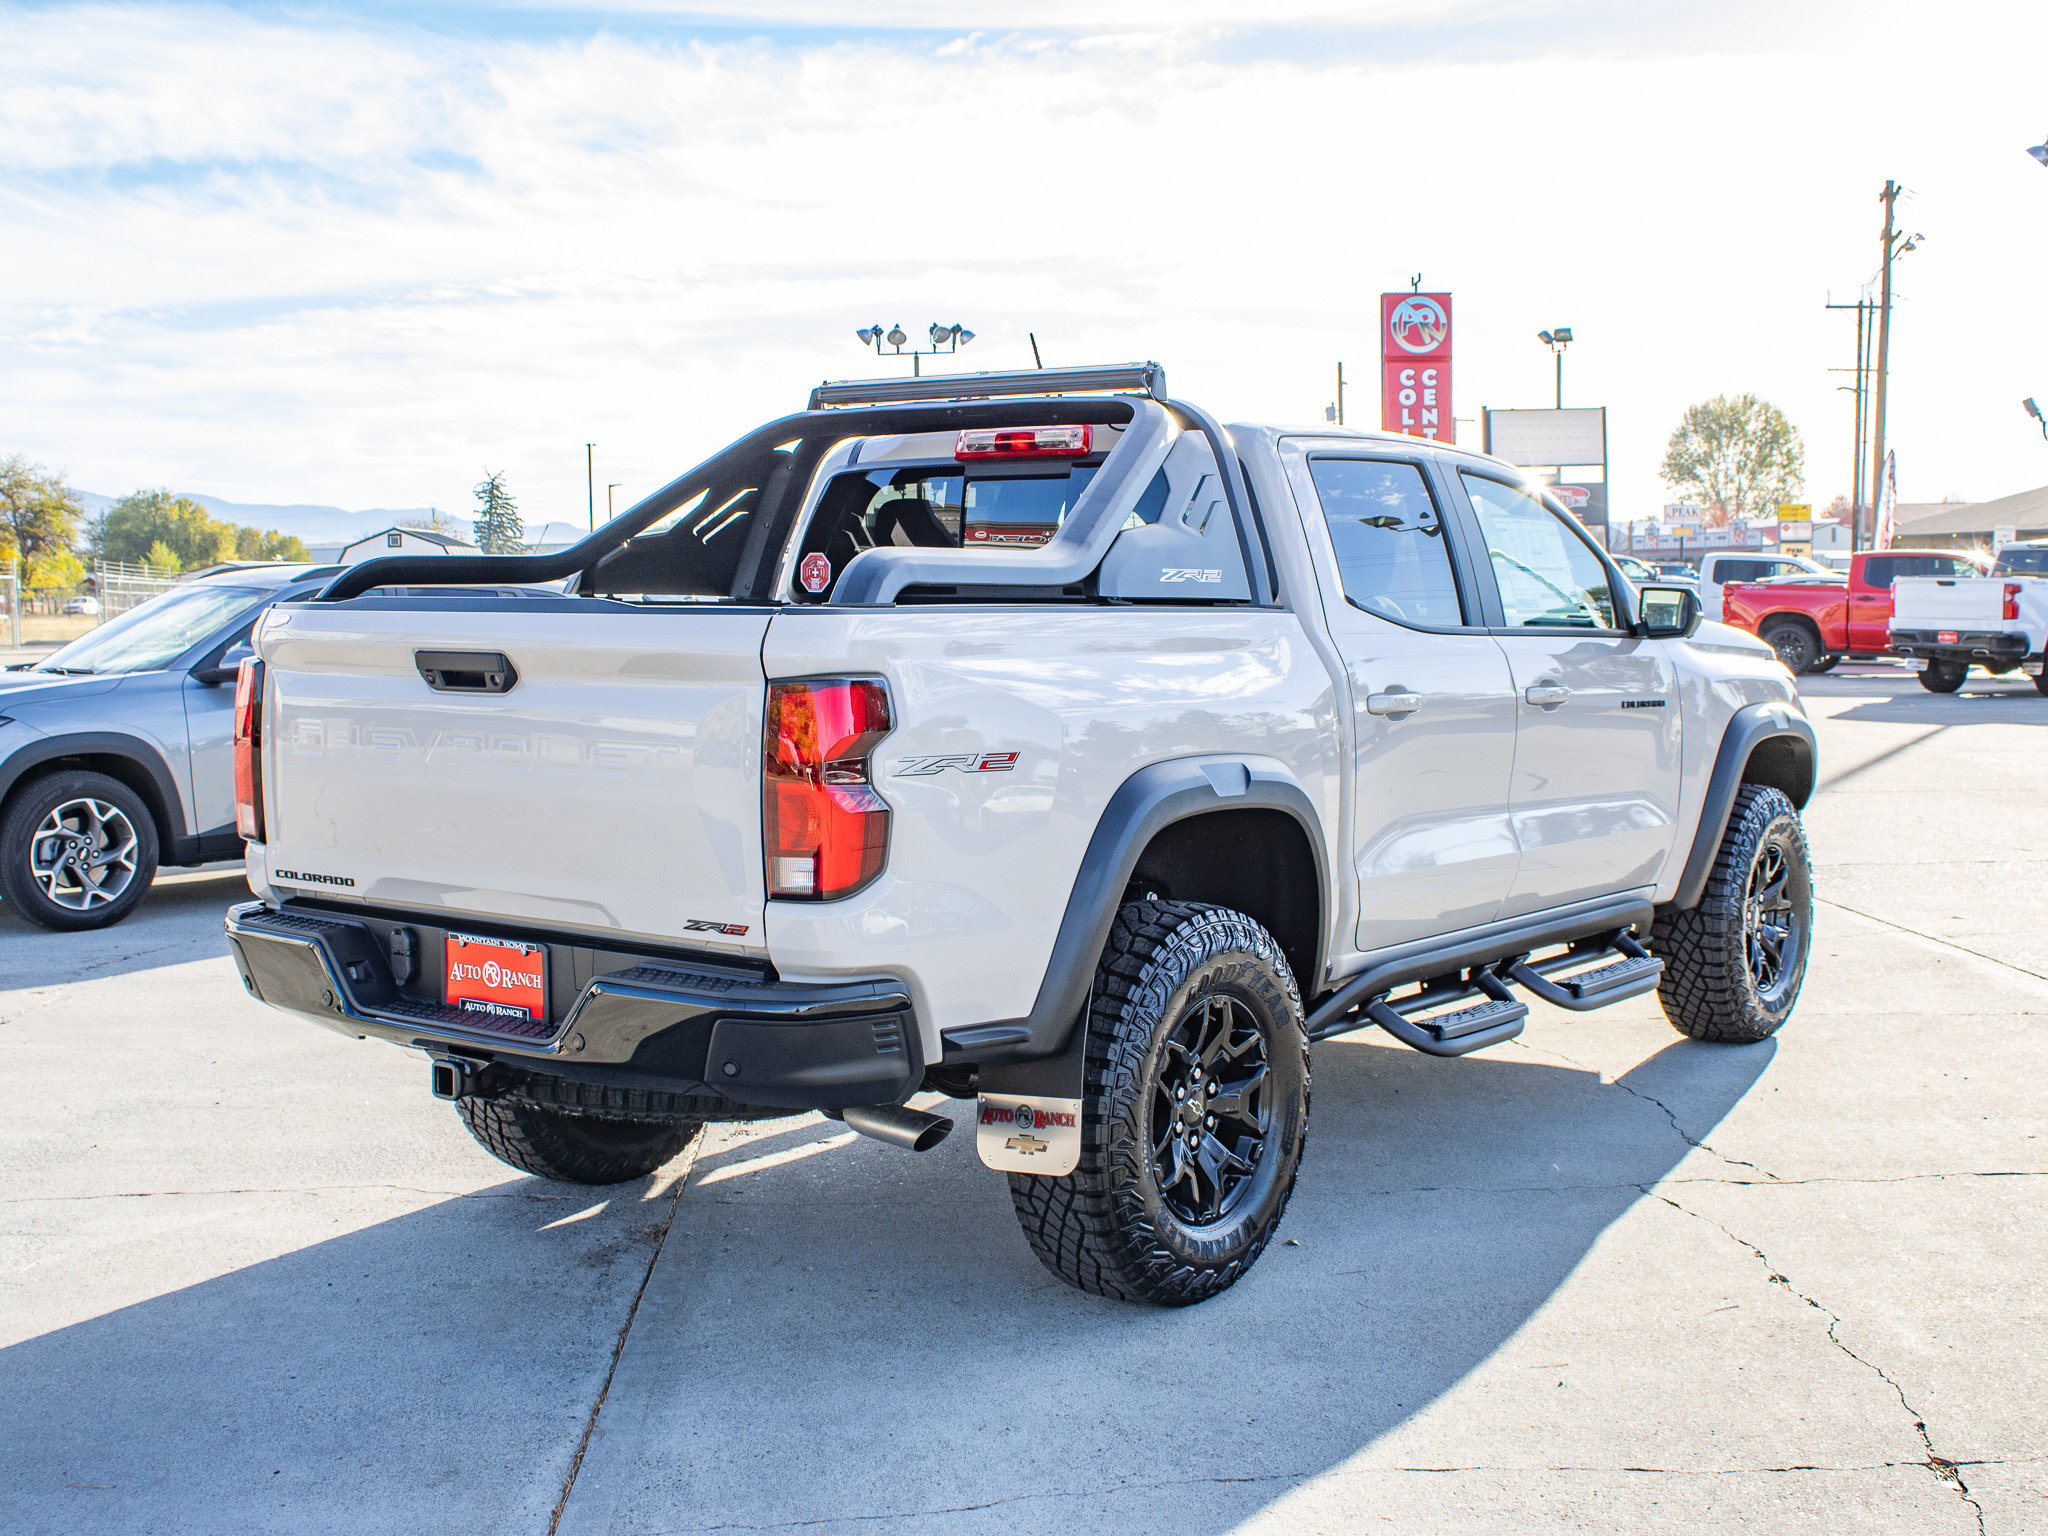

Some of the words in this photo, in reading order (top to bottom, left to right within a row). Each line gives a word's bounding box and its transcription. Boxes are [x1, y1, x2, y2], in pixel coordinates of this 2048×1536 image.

[1672, 507, 1698, 517] PEAK
[1160, 568, 1223, 583] ZR2
[893, 751, 1020, 778] ZR2
[275, 869, 355, 887] COLORADO
[683, 919, 749, 937] ZR2
[449, 961, 481, 982] AUTO
[501, 968, 542, 989] RANCH
[1185, 959, 1291, 1031] GOODYEAR
[464, 1002, 486, 1012] AUTO
[496, 1007, 523, 1018] RANCH
[980, 1105, 1014, 1125] AUTO
[1034, 1109, 1077, 1129] RANCH
[1157, 1211, 1259, 1260] WRANGLER
